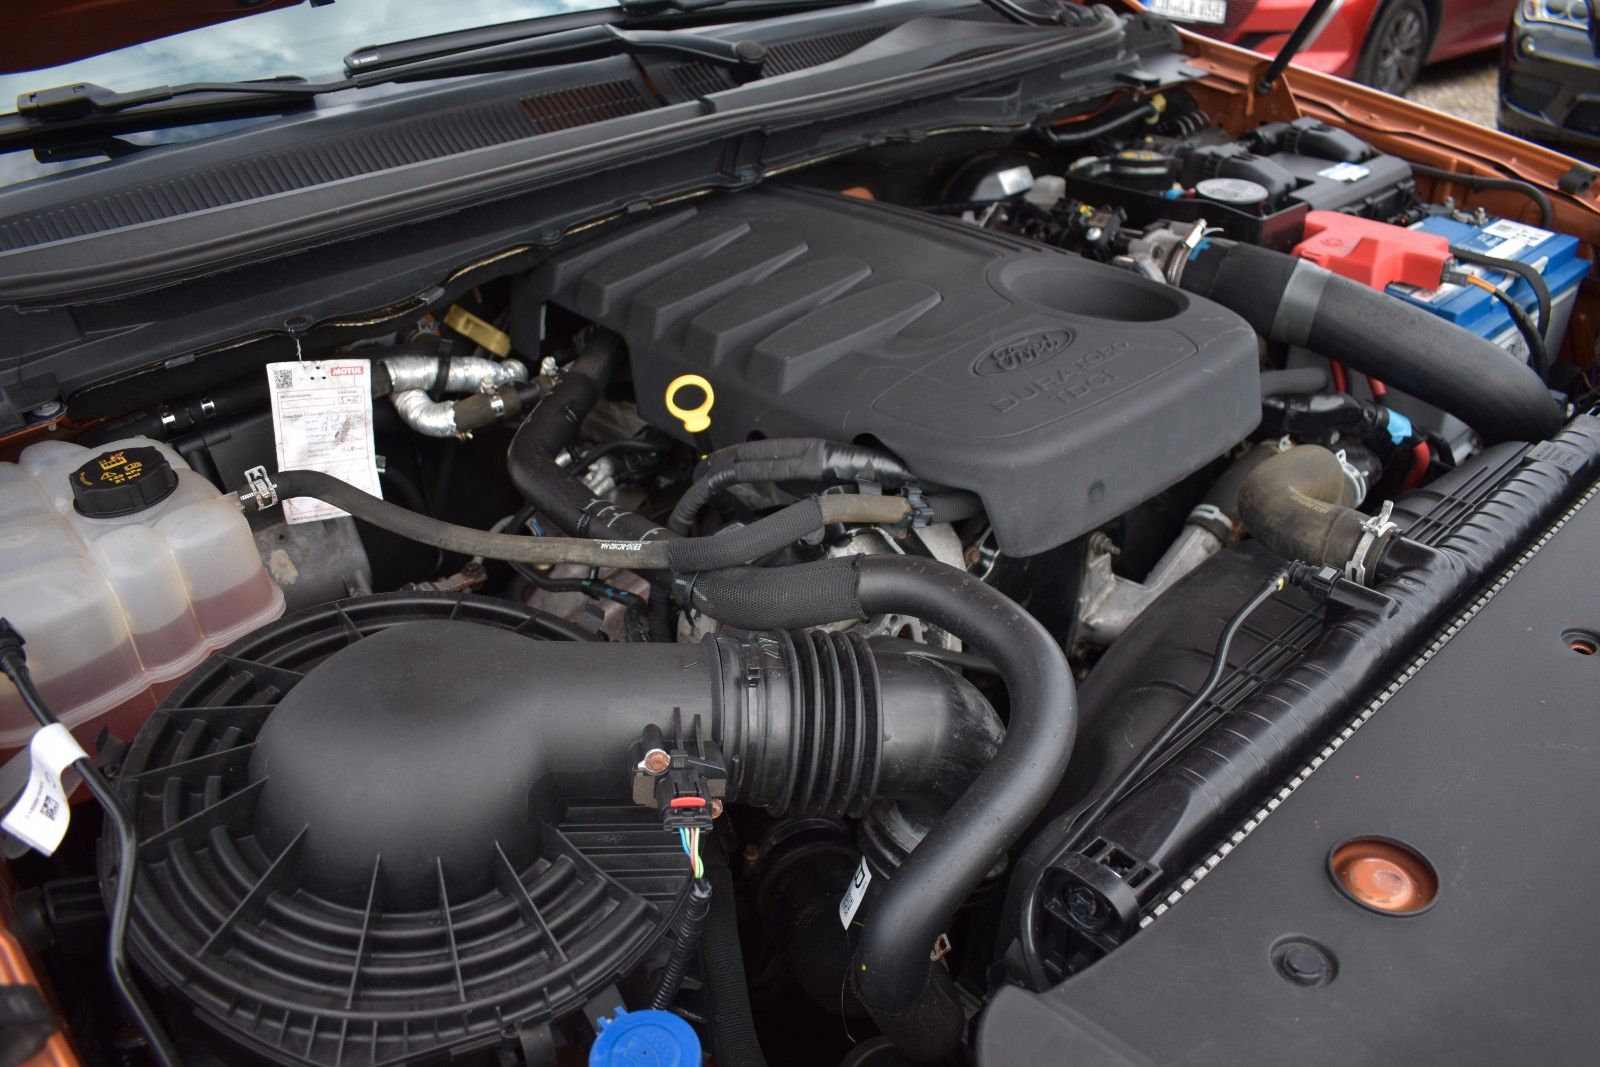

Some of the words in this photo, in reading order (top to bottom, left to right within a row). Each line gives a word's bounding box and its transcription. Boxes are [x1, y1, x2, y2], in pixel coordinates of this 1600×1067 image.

[992, 334, 1060, 371] Ford
[332, 367, 363, 376] MOTUL
[990, 341, 1131, 413] DURATORQ
